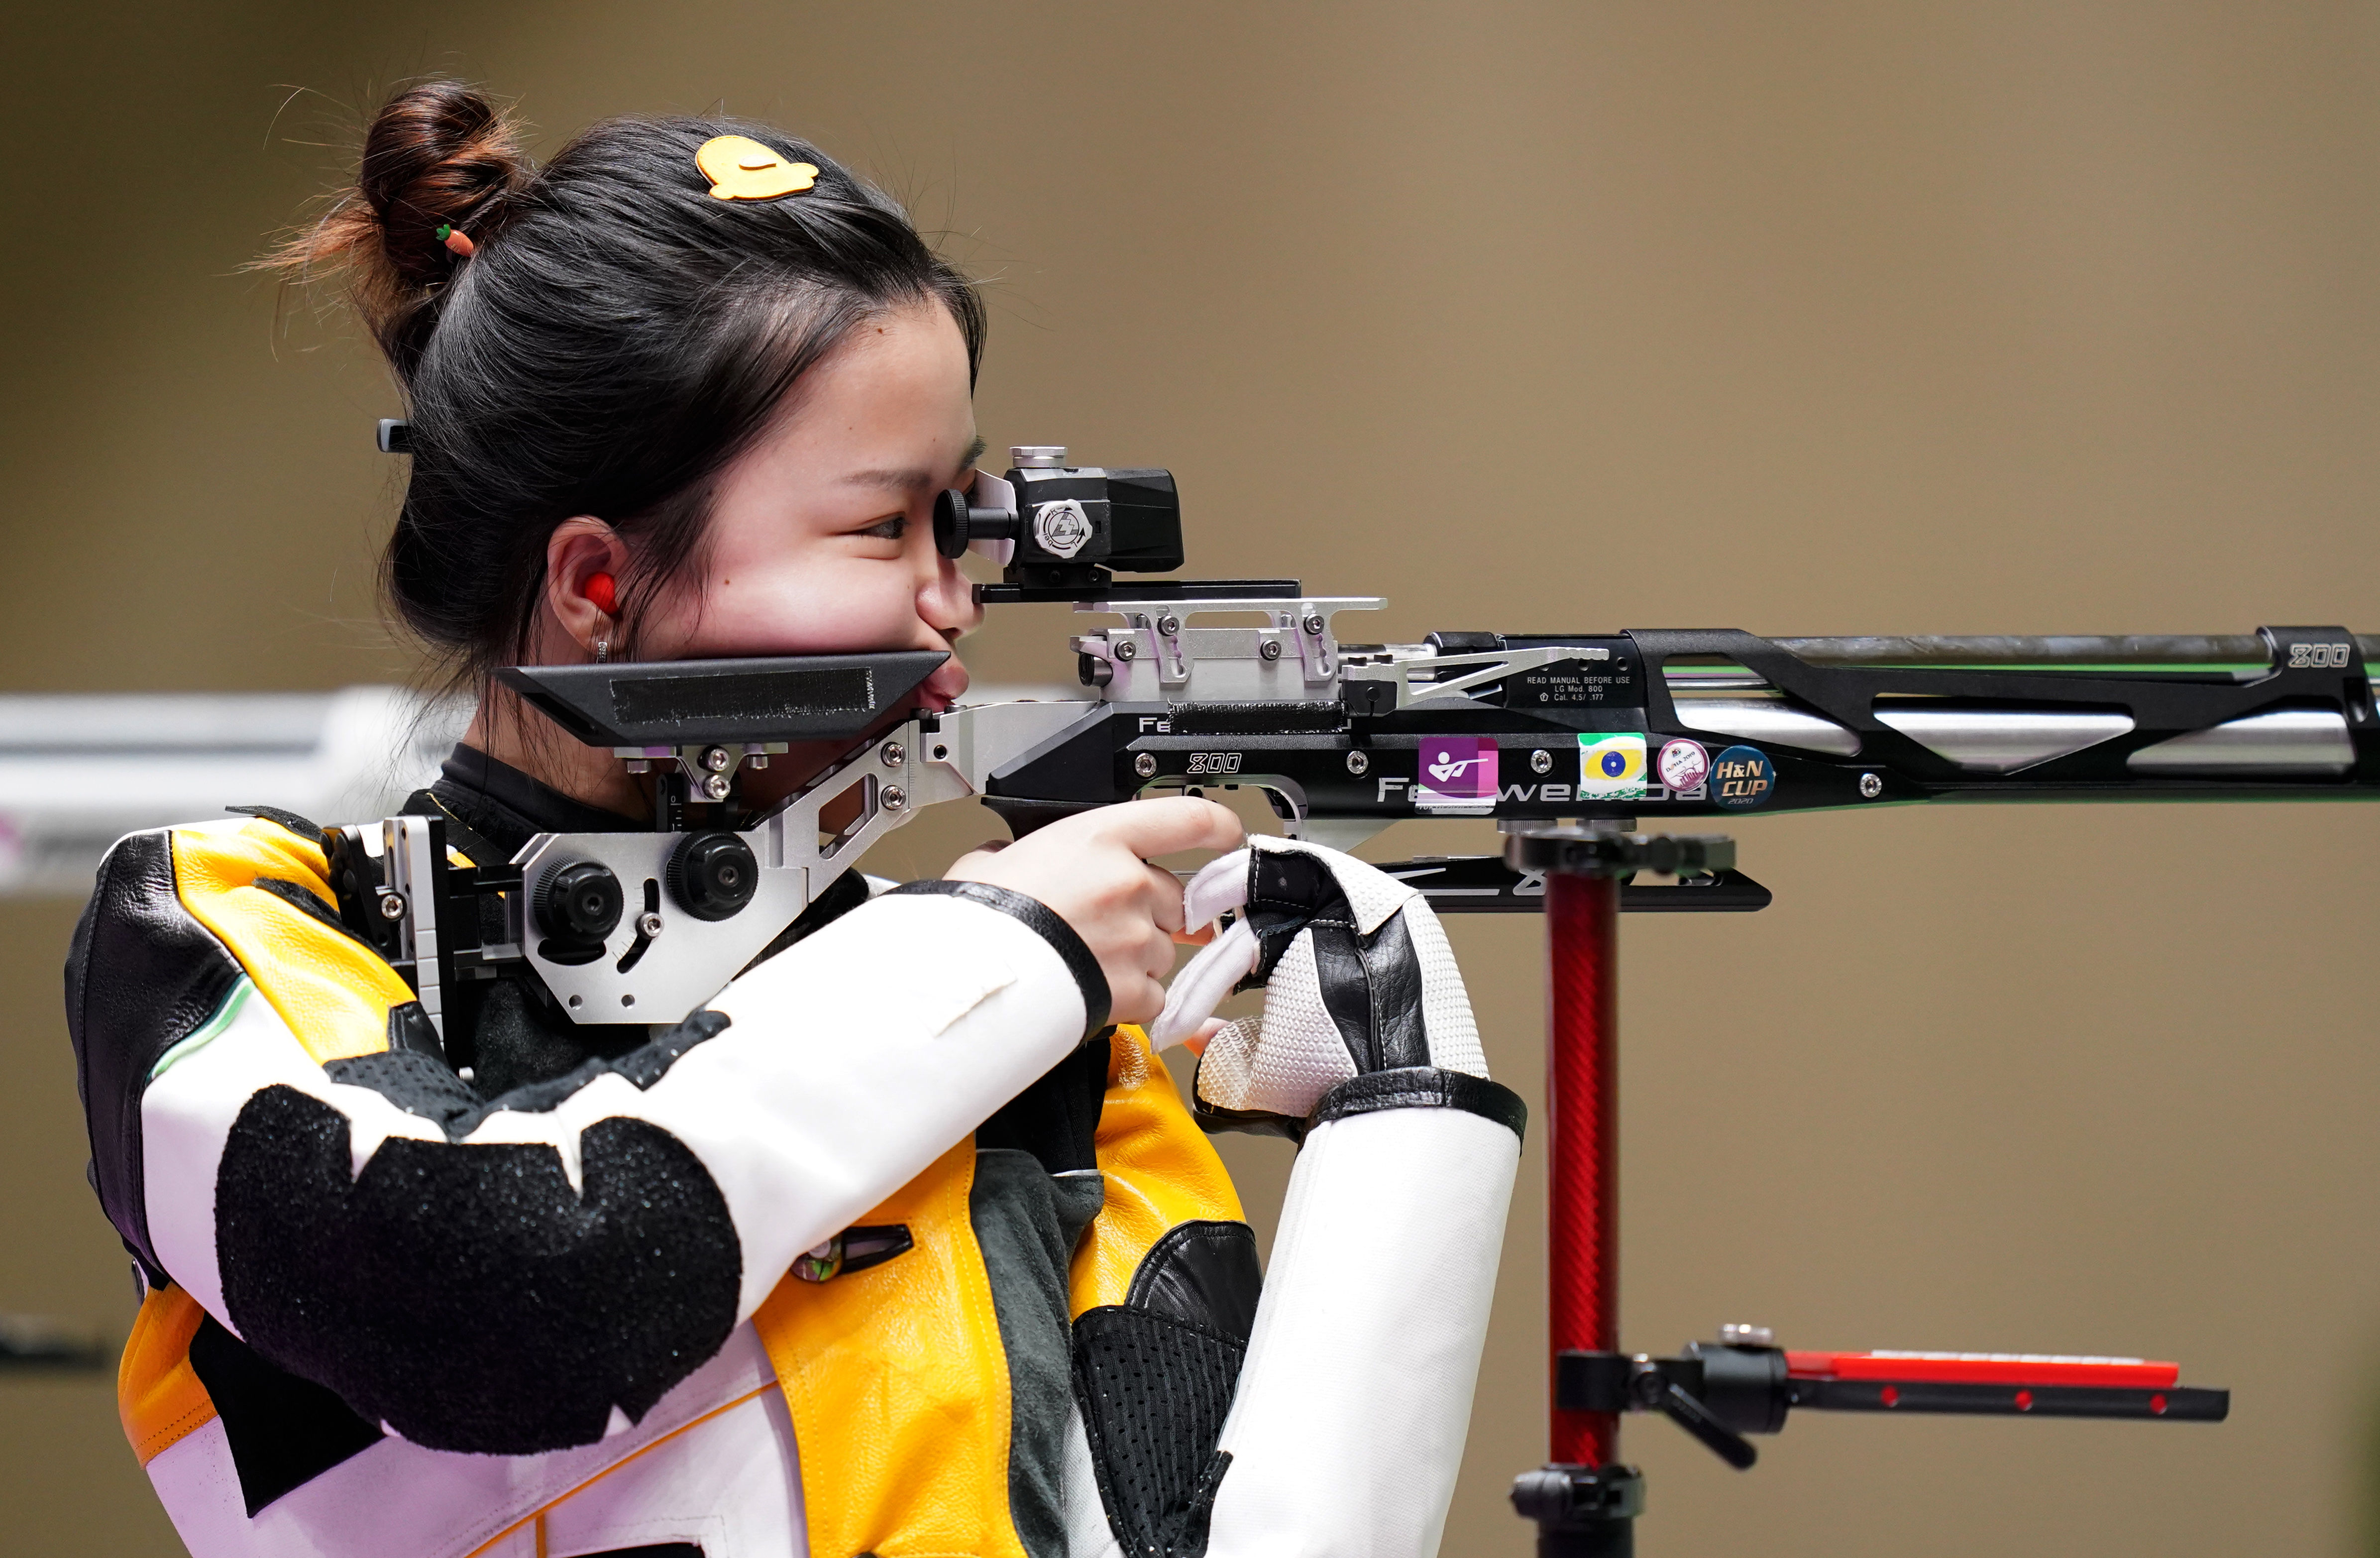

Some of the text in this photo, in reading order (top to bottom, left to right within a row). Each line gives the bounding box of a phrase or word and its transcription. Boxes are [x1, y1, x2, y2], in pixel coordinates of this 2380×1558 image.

[2288, 643, 2351, 668] 800
[1187, 753, 1242, 774] 800
[1717, 761, 1764, 779] H&N
[1722, 780, 1768, 796] CUP
